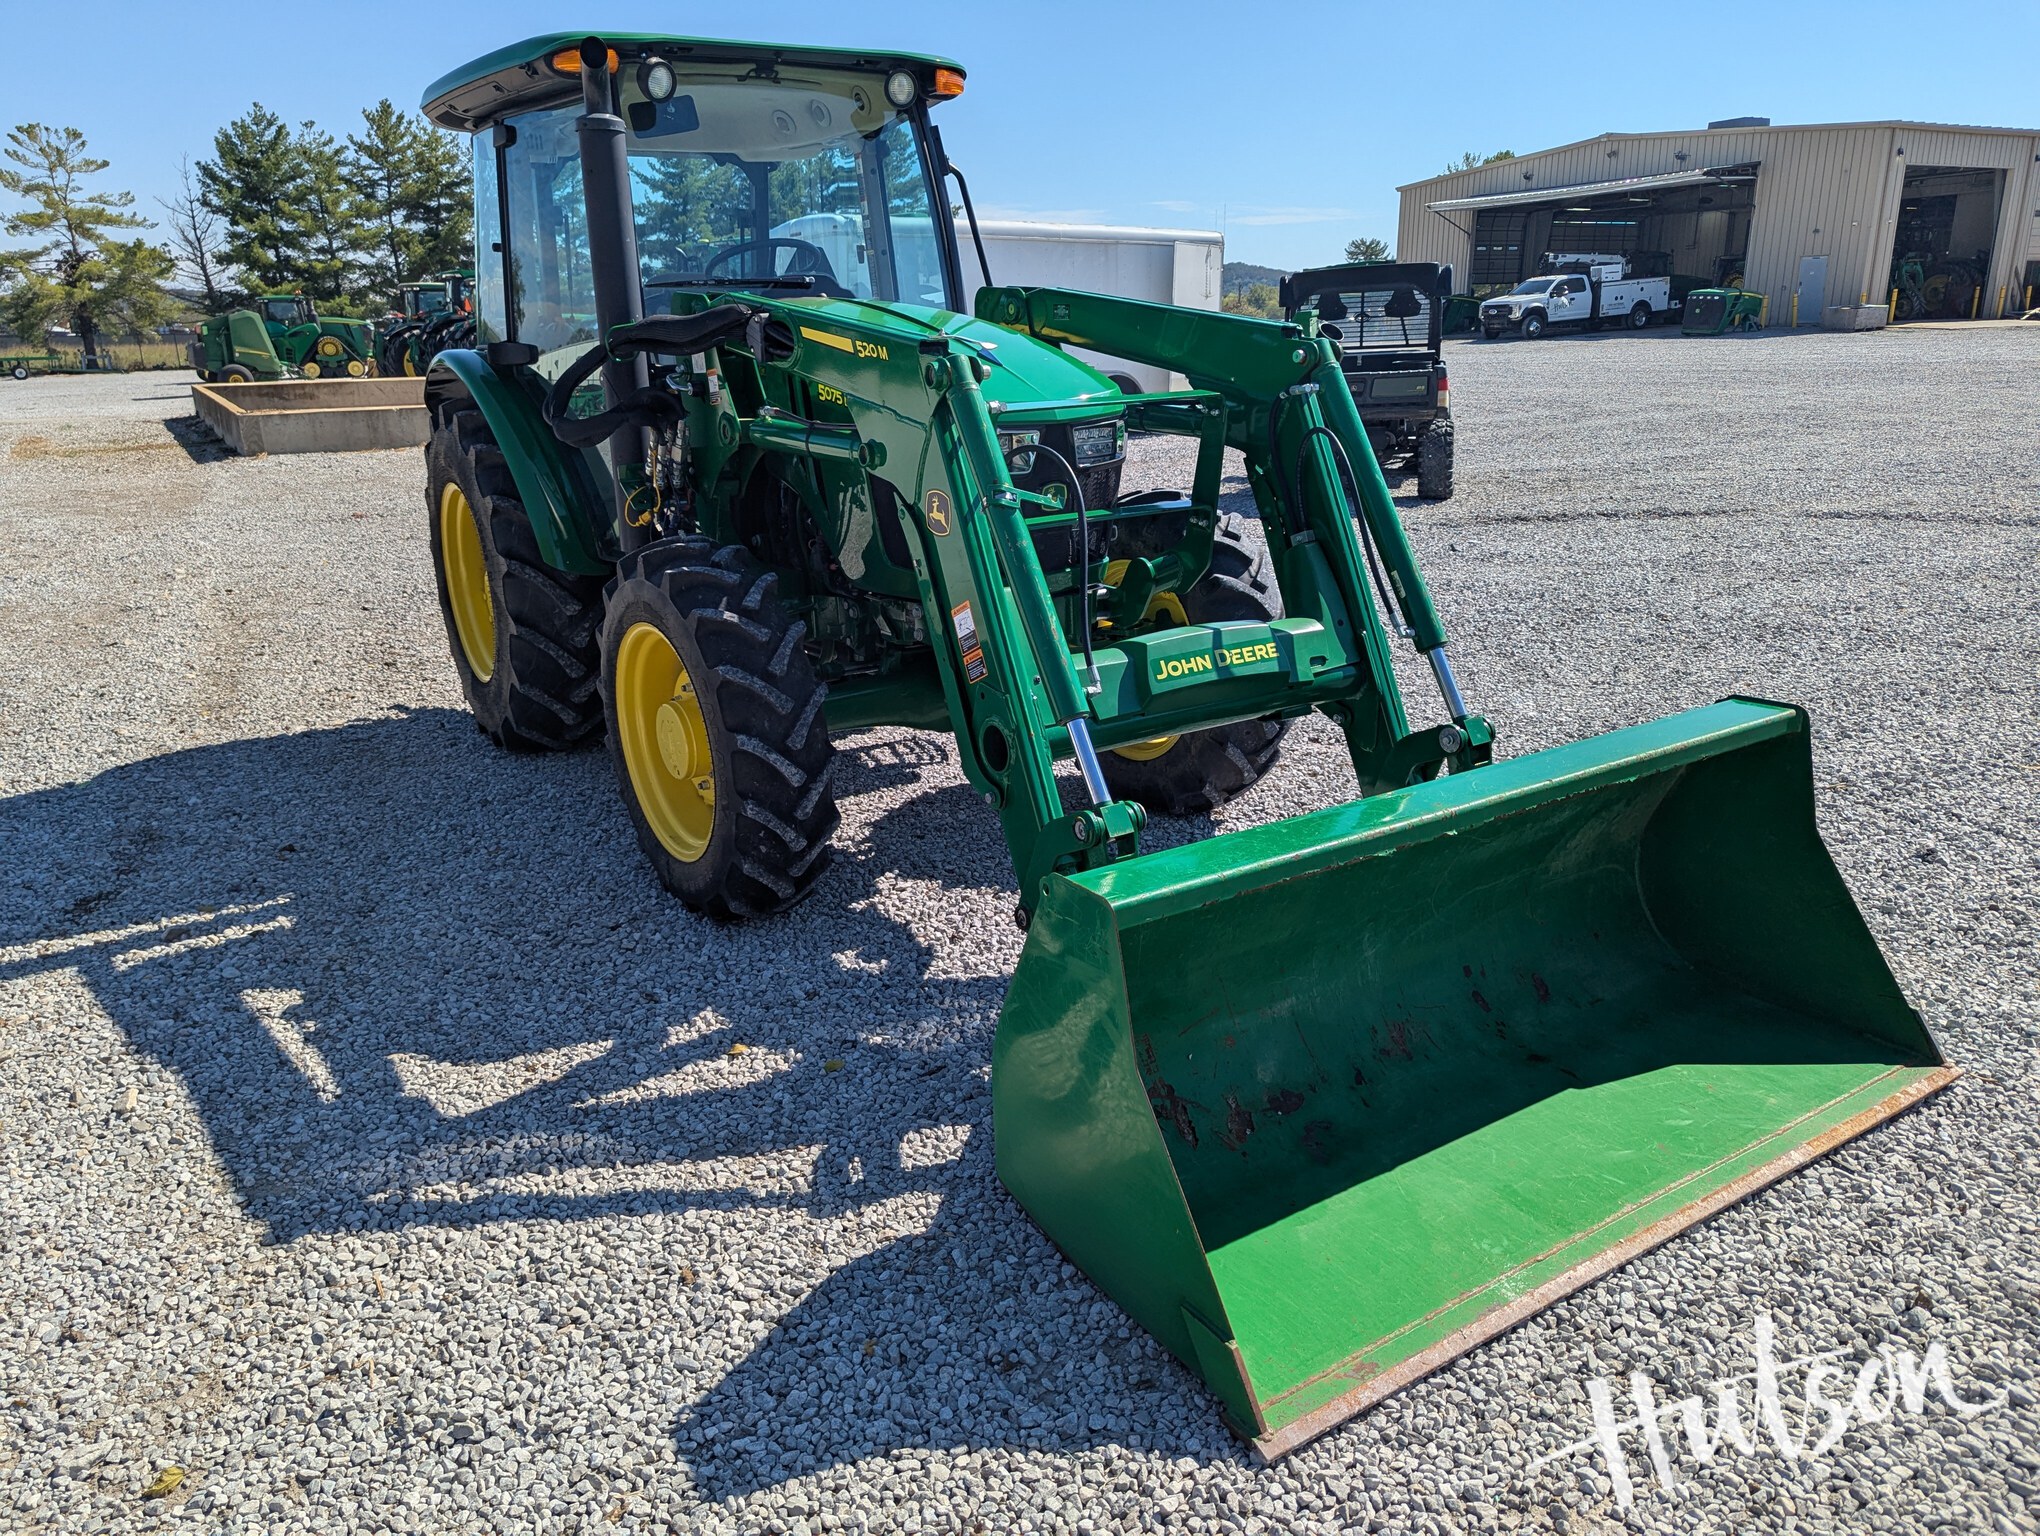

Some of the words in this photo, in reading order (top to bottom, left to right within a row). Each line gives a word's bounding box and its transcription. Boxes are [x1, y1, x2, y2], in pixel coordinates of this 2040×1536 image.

[855, 340, 878, 358] 520
[1156, 654, 1213, 680] JOHN
[1214, 642, 1280, 668] DEERE
